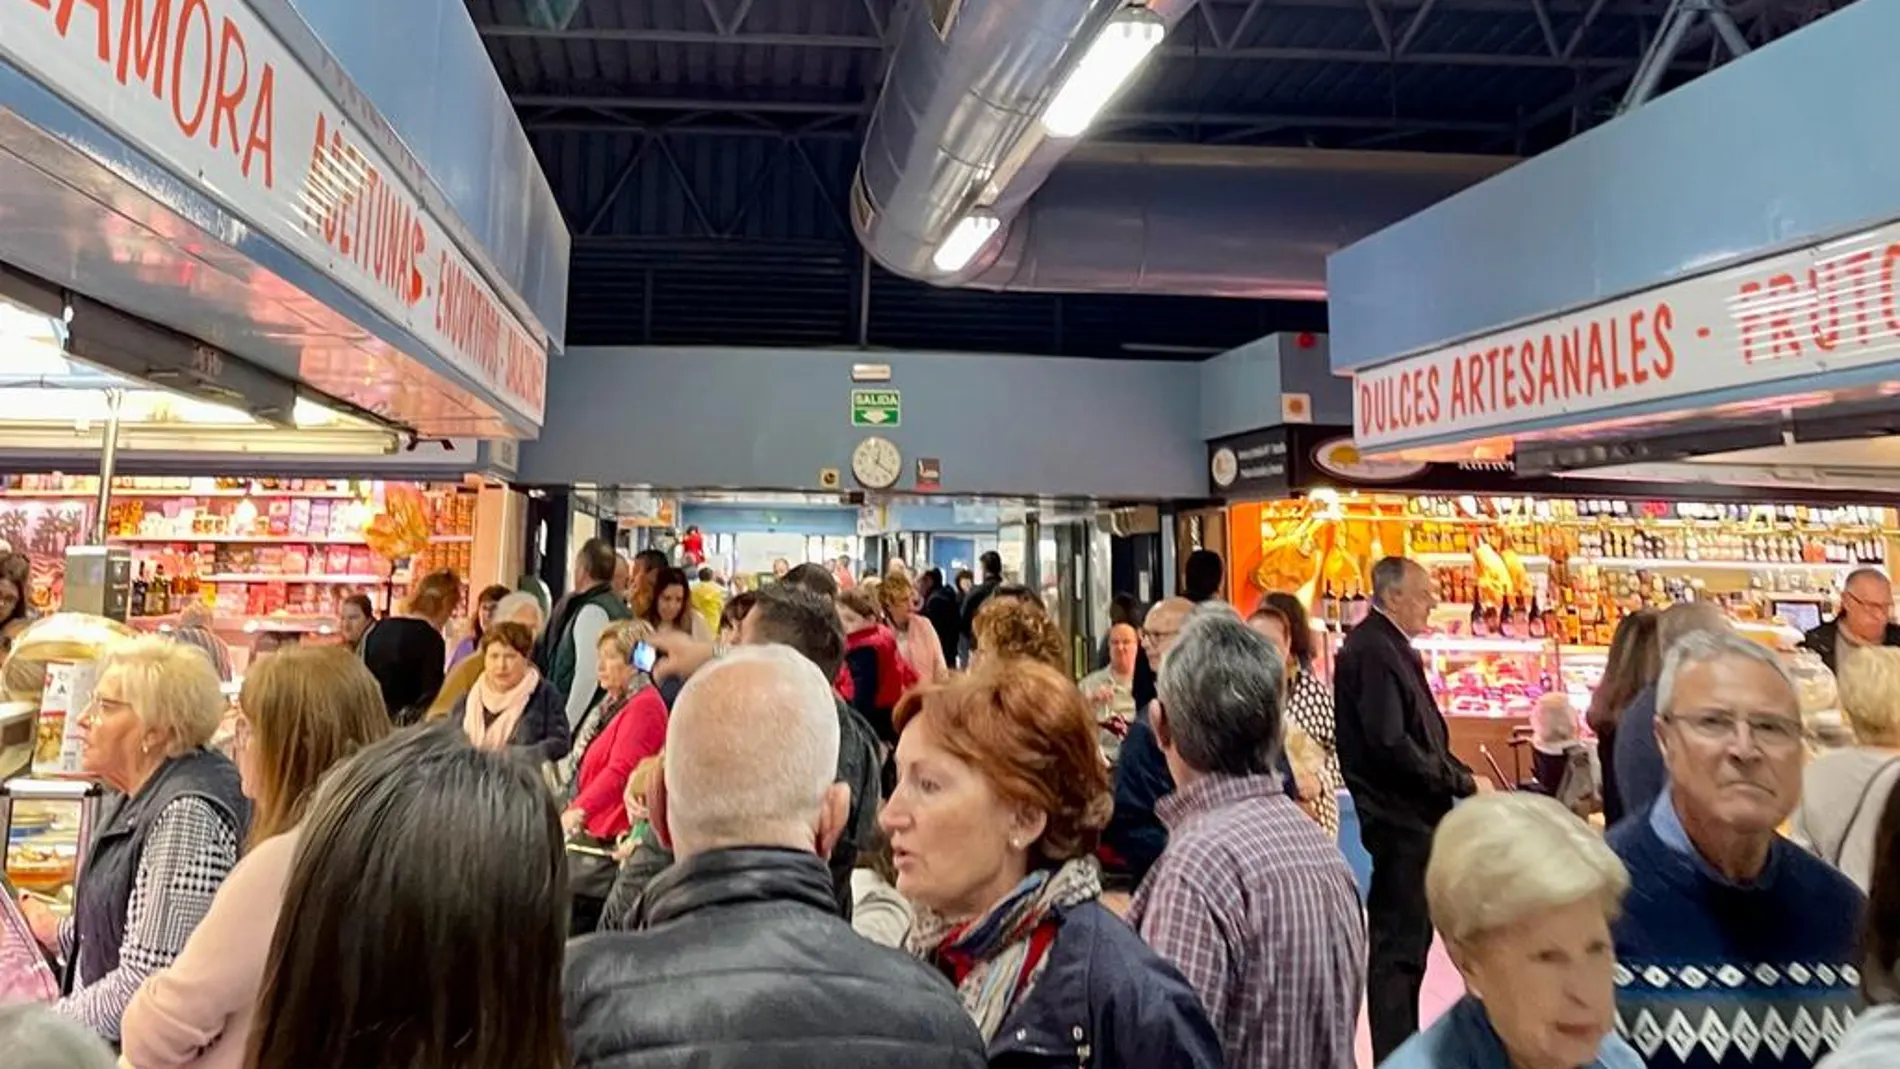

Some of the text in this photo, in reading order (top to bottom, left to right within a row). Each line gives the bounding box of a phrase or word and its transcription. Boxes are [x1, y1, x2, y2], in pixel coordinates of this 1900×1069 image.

[855, 393, 898, 406] SALIDA
[1360, 365, 1440, 436] DULCES
[1450, 302, 1676, 418] ARTESANALES
